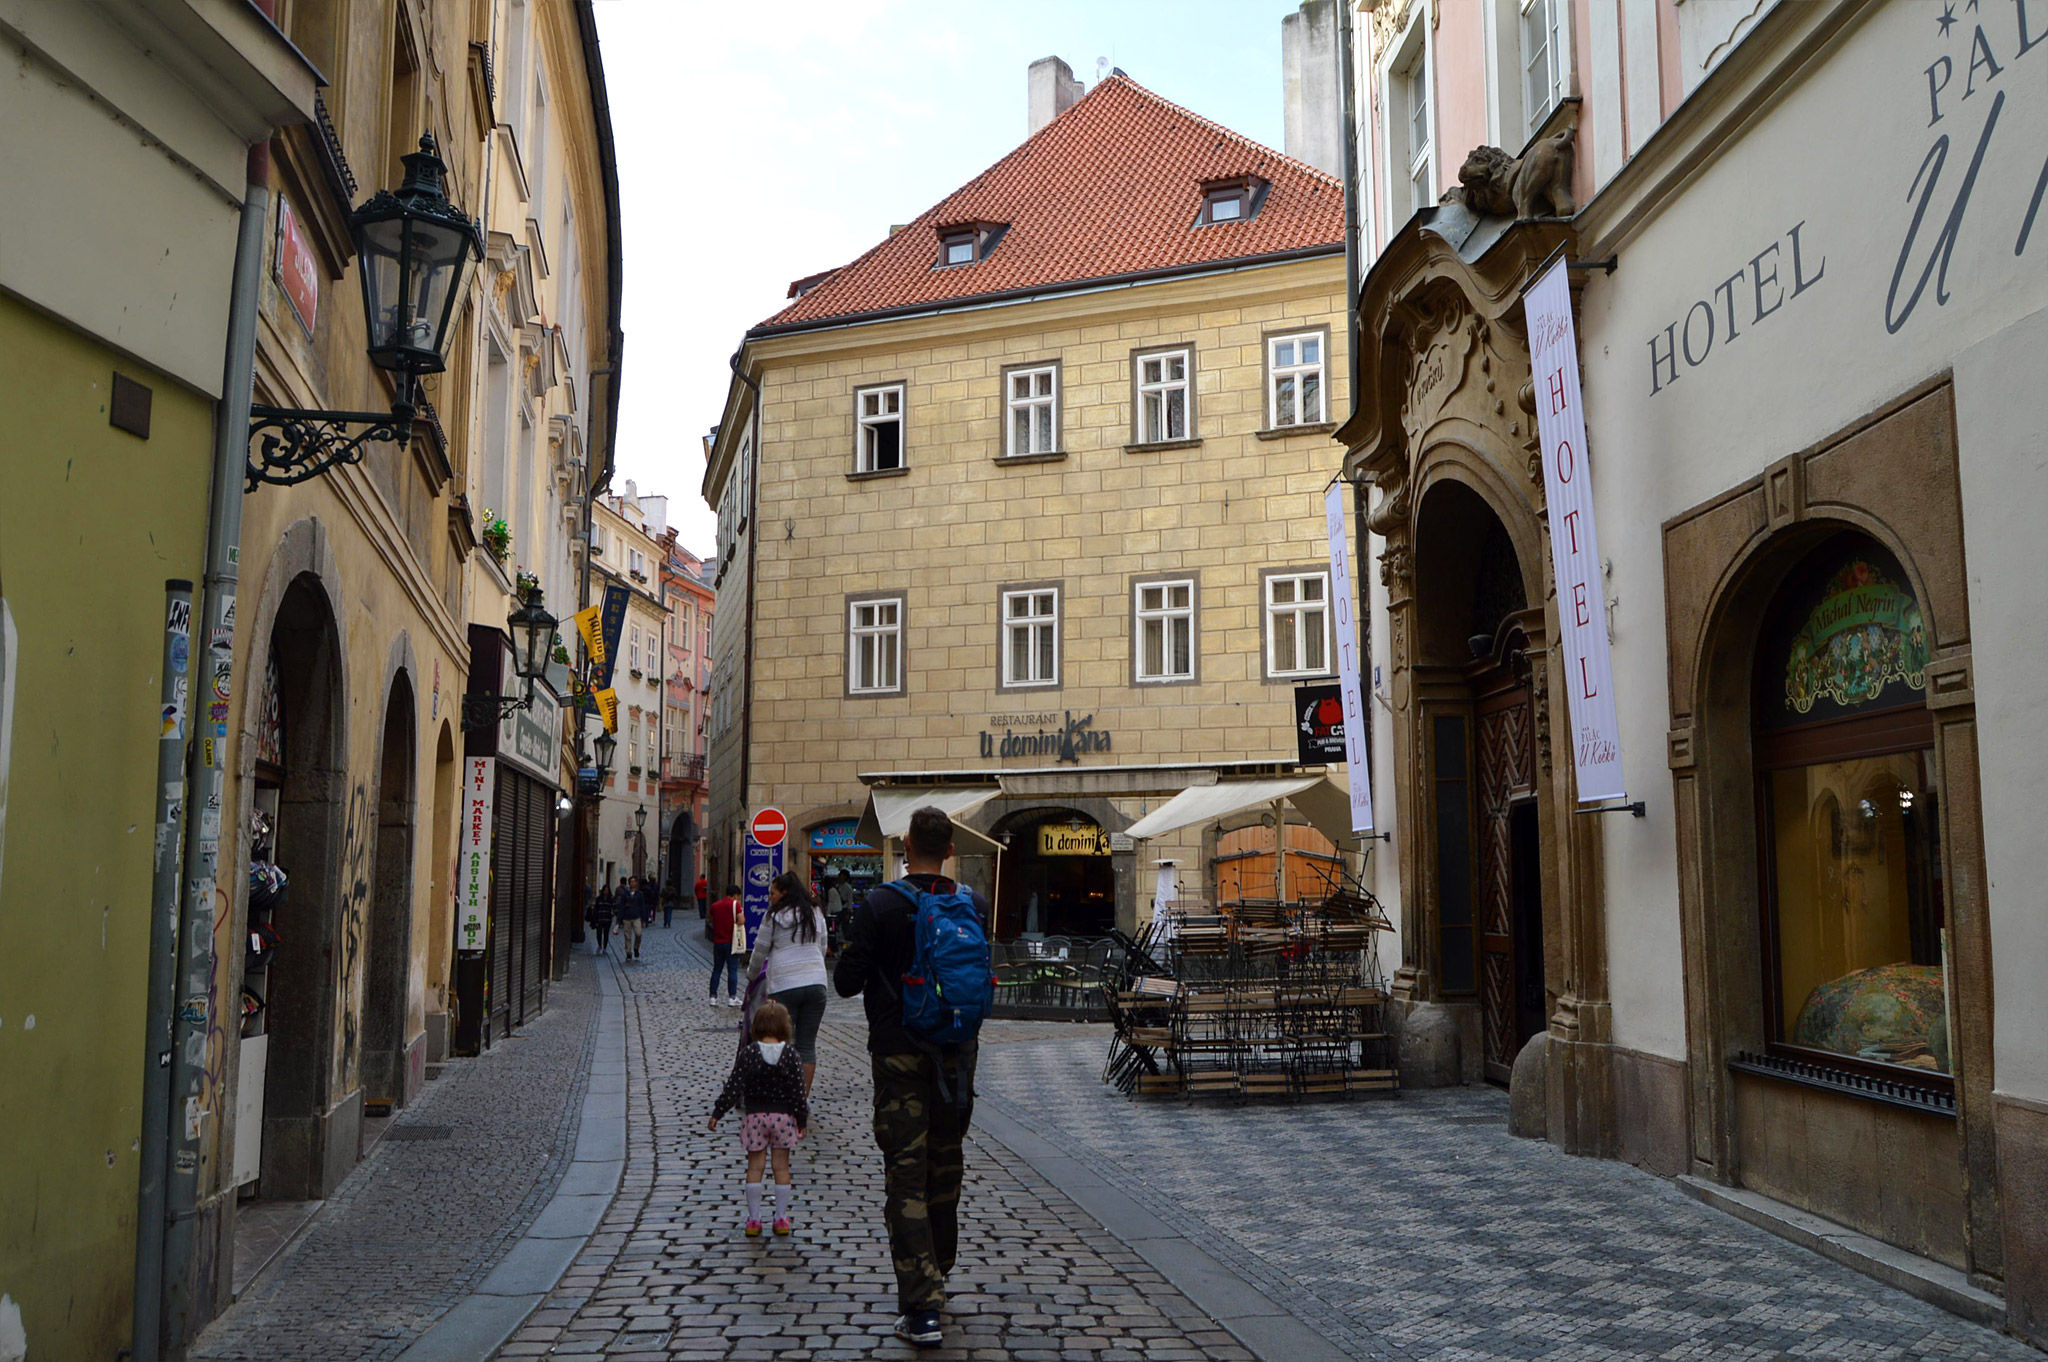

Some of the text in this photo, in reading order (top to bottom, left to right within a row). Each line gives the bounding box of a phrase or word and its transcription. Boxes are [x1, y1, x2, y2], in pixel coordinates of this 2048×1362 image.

[1646, 219, 1826, 397] HOTEL
[1547, 366, 1598, 700] HOTEL
[1814, 592, 1895, 636] Michal Negrin
[1334, 549, 1360, 765] HOTEL
[990, 713, 1058, 727] RESTAURANT
[979, 730, 993, 758] U
[473, 760, 486, 792] MINI
[471, 799, 484, 846] MARKET
[820, 826, 860, 836] SOUV
[1044, 833, 1054, 851] U
[468, 852, 481, 907] ABSINTH
[467, 914, 477, 946] SOP
